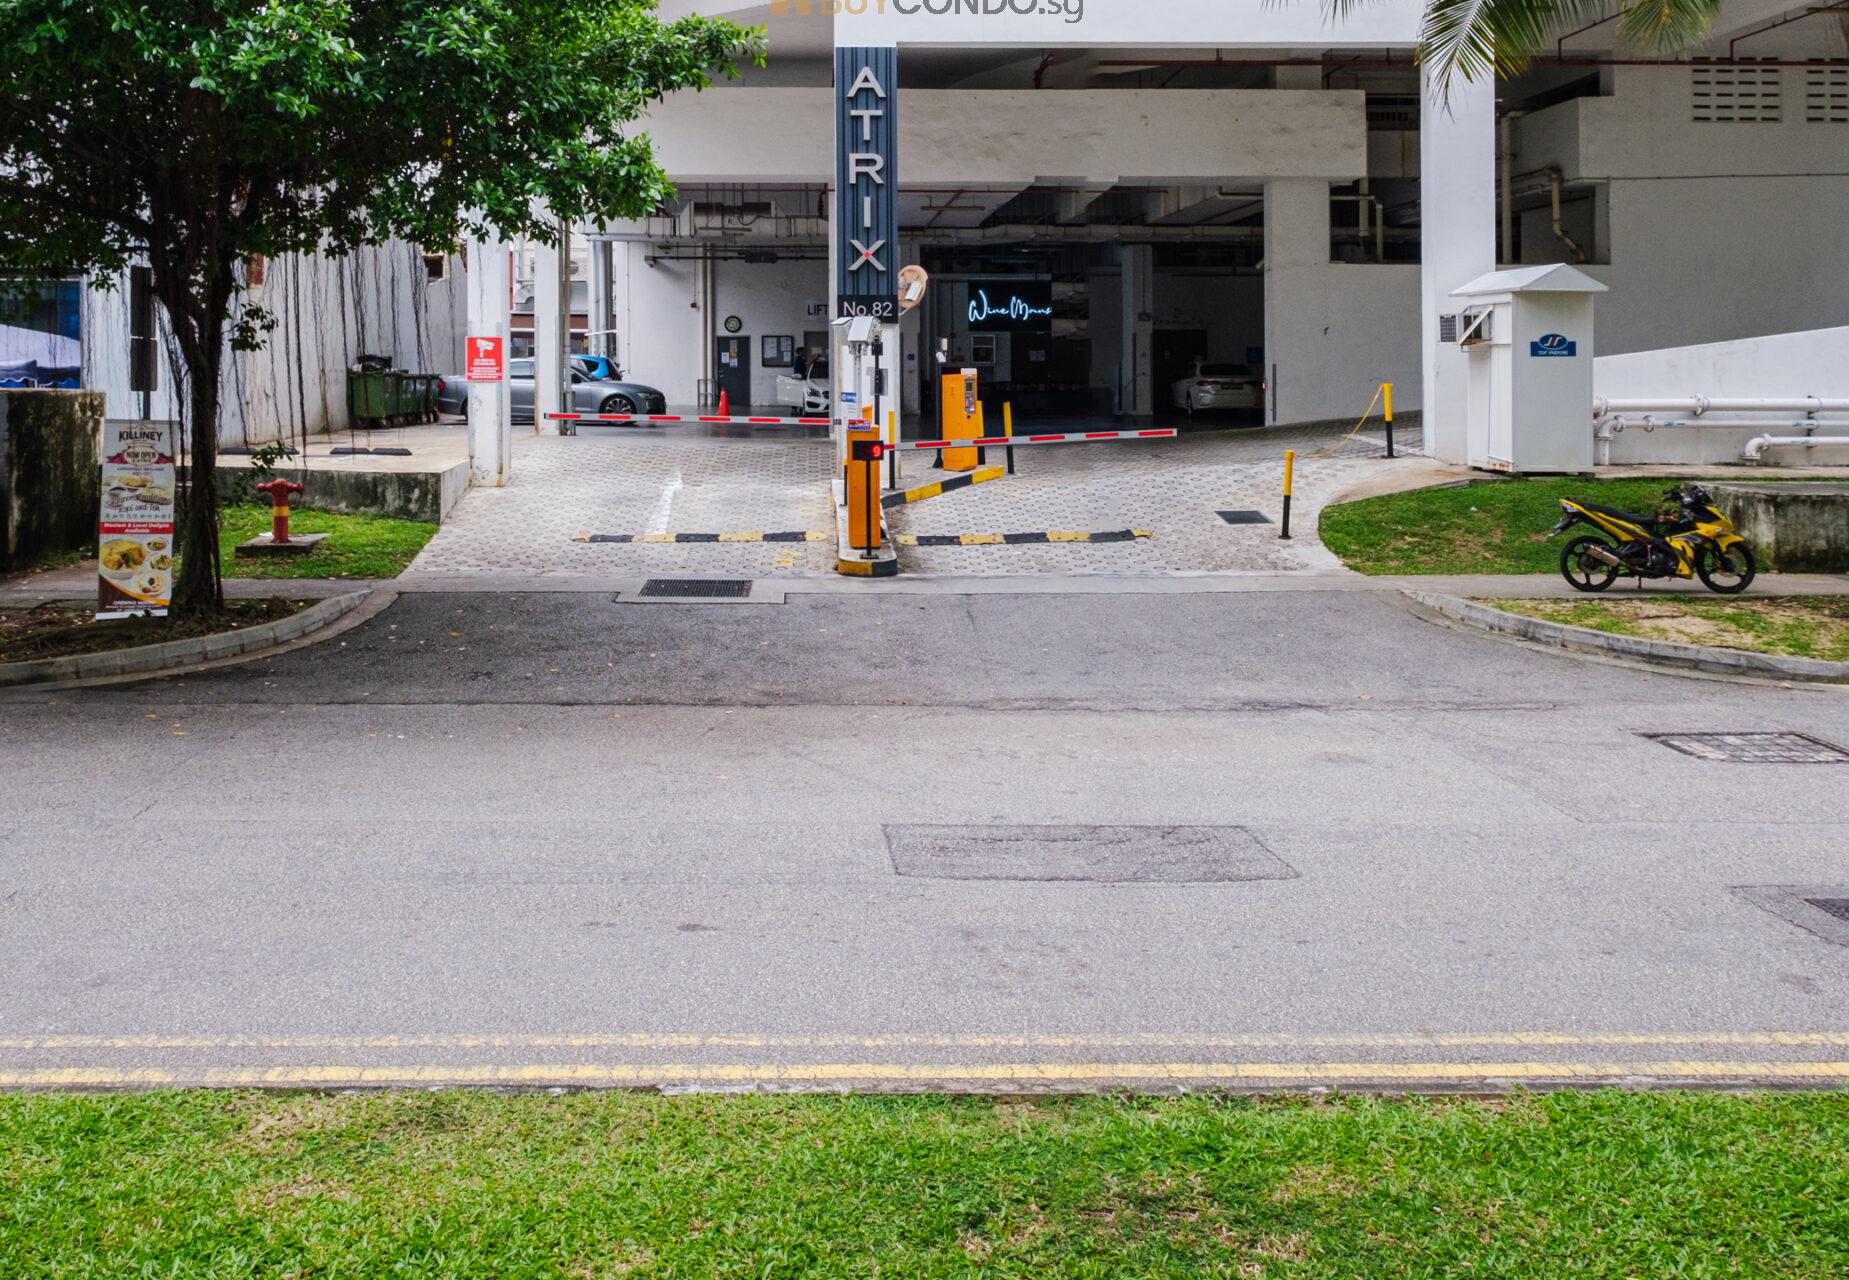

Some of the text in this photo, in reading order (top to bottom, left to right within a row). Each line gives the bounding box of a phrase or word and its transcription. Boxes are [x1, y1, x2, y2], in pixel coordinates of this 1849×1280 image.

[847, 66, 887, 271] ATRIX
[808, 304, 829, 316] LIFT
[843, 301, 892, 317] No.82
[968, 289, 1010, 322] Wine
[119, 431, 163, 442] KILLINEY
[872, 445, 881, 457] 9
